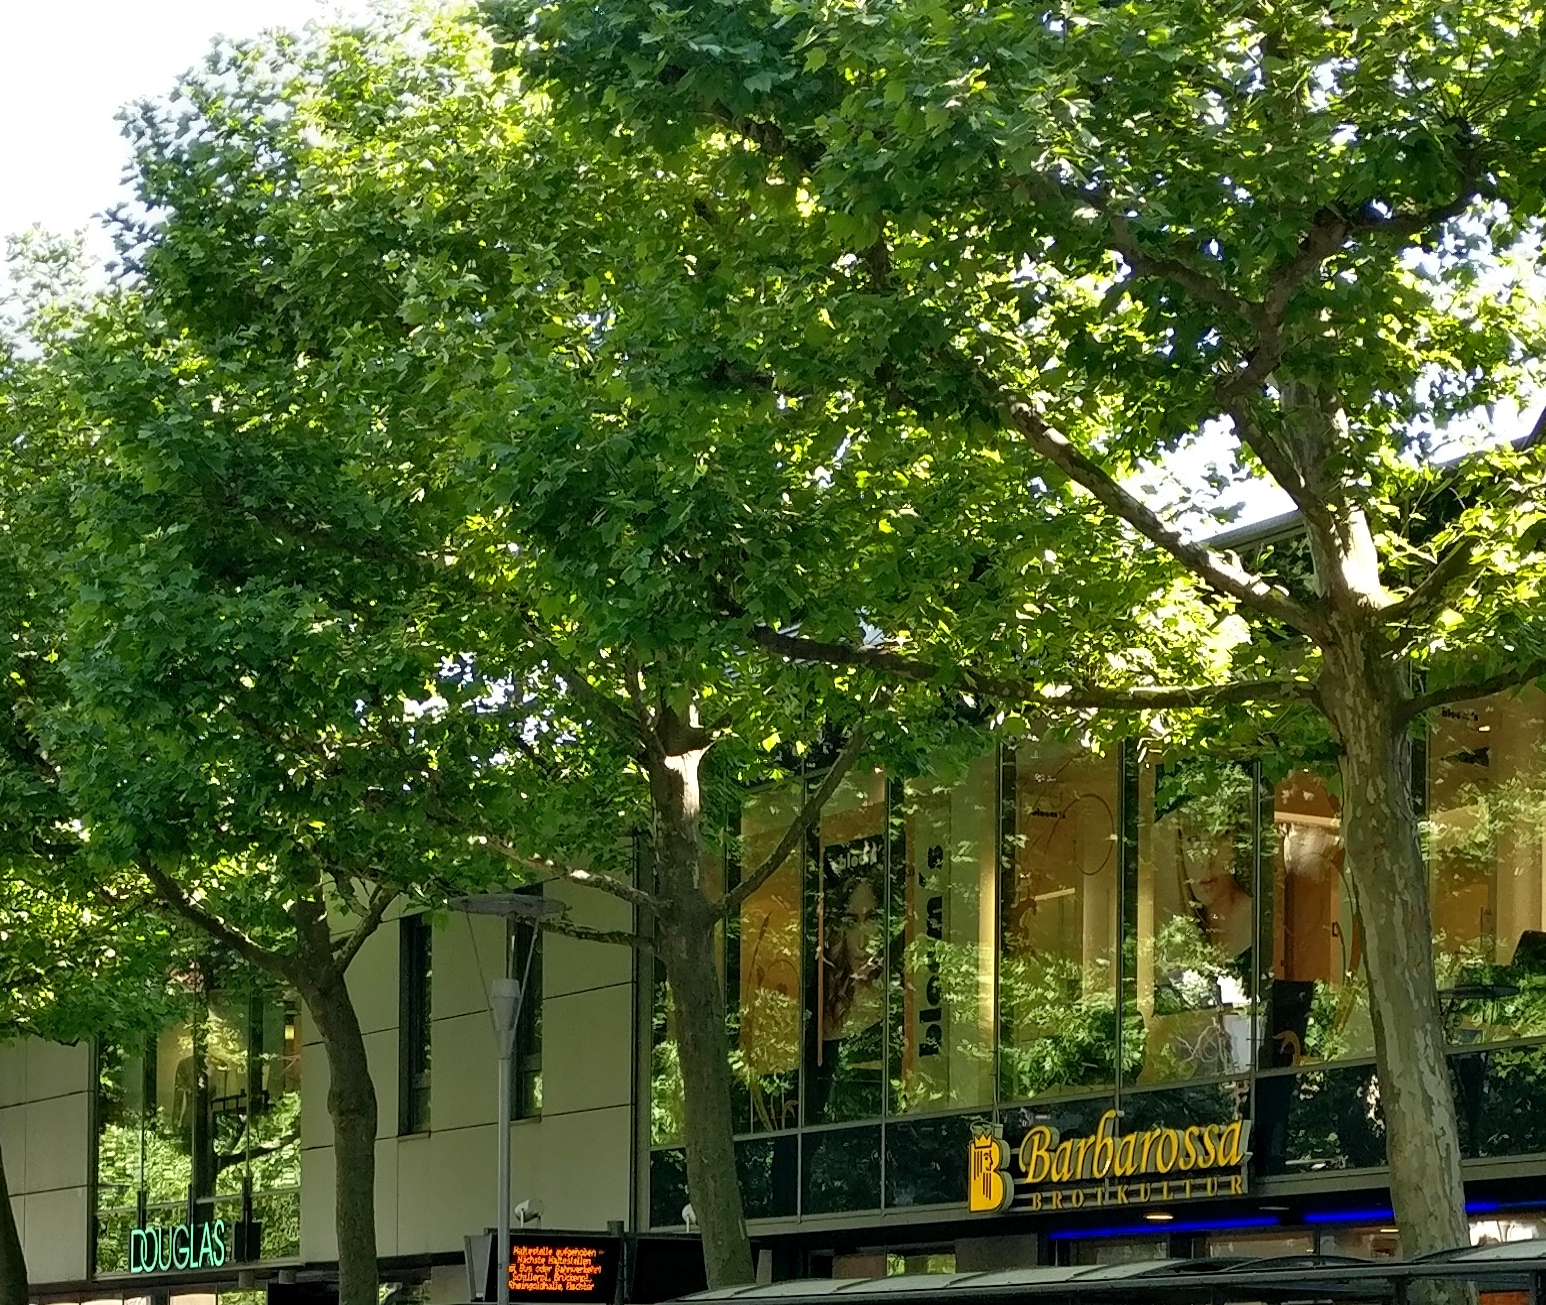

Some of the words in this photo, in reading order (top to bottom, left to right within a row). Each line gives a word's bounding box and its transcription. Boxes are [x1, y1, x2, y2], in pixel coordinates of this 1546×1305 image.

[1018, 1109, 1245, 1184] Barbarossa
[1031, 1175, 1244, 1212] BROTKULTUR
[130, 1218, 225, 1274] DOUGLAS
